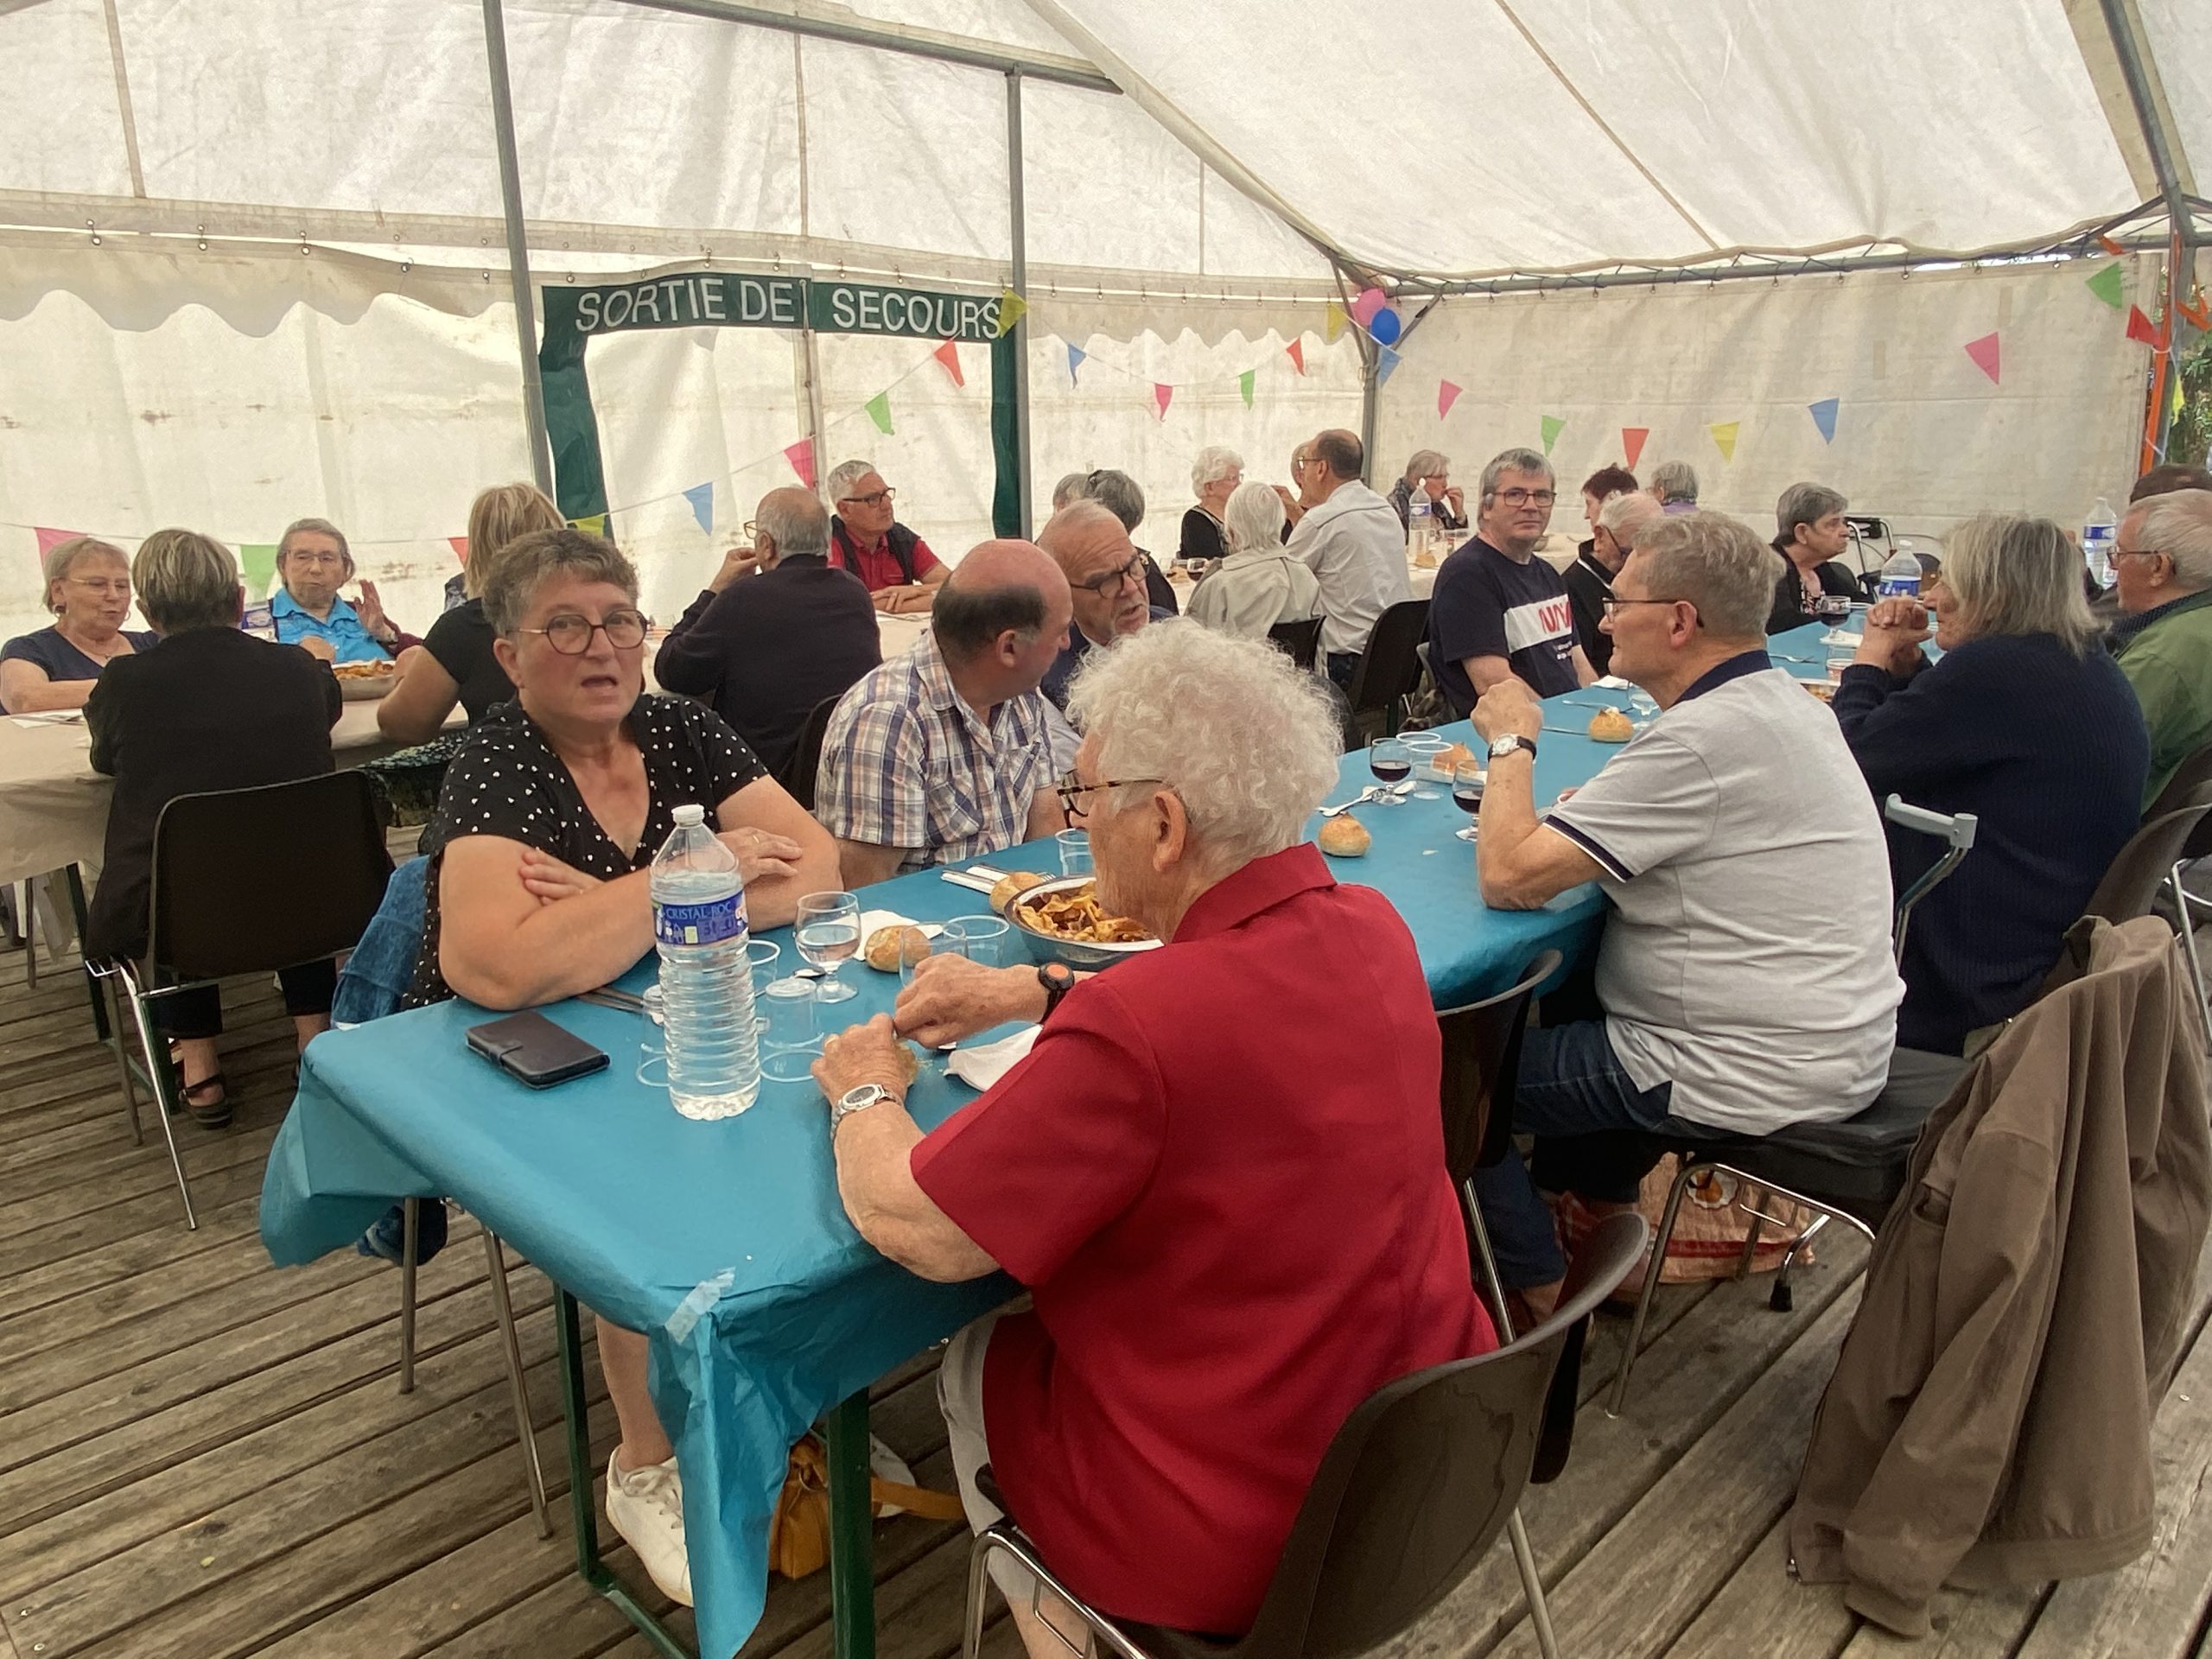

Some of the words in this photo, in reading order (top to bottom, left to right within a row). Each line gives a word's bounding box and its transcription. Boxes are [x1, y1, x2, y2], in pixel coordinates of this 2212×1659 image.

[574, 277, 726, 332] SORTIE
[739, 280, 795, 322] DE
[831, 288, 1001, 340] SECOURS
